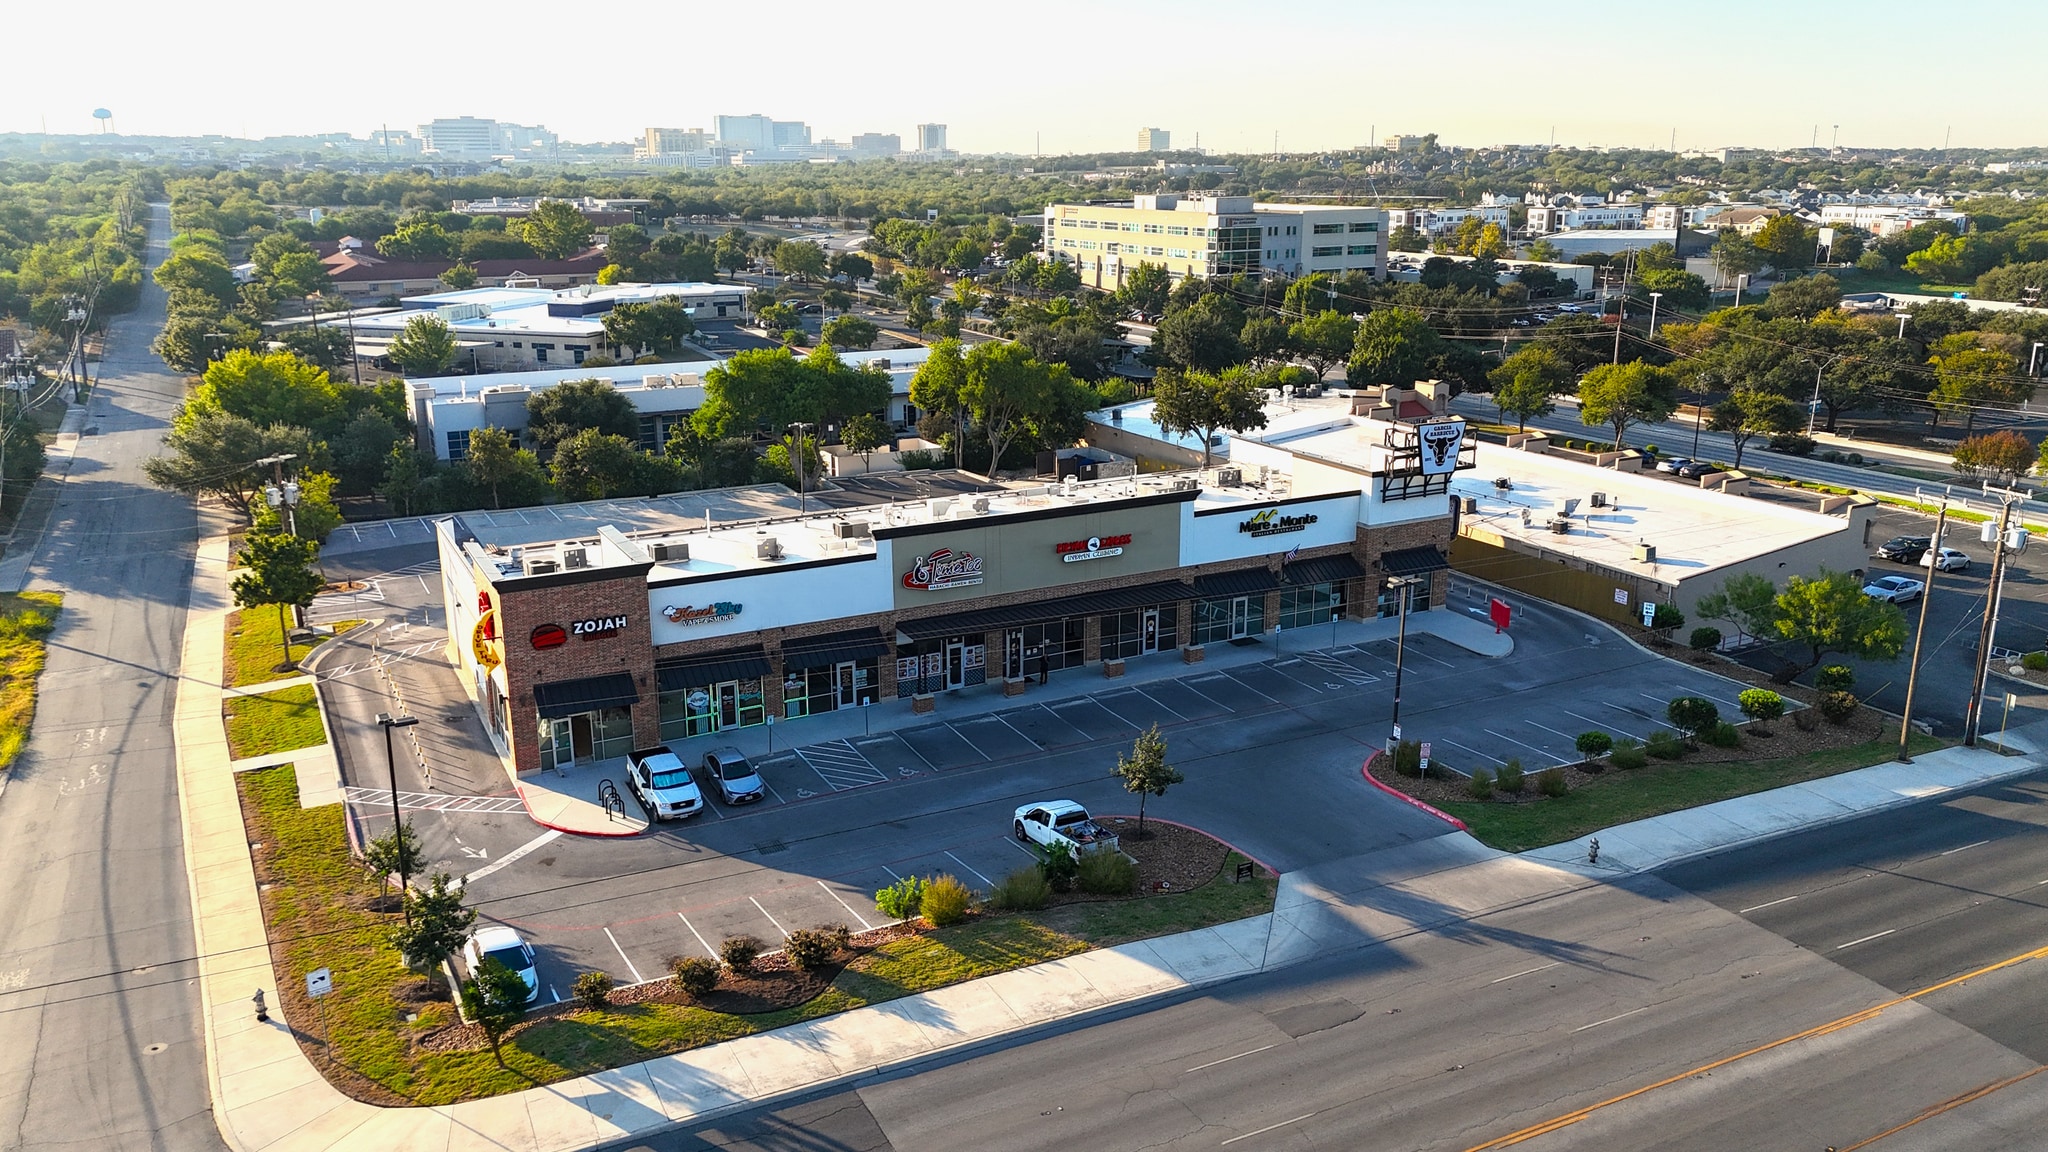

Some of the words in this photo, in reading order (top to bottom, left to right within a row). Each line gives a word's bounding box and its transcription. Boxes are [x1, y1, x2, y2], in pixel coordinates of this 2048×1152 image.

[1279, 513, 1319, 528] Monte
[573, 616, 627, 635] ZOJAH
[682, 618, 701, 627] VAPE
[709, 614, 734, 624] SMOKE
[474, 624, 484, 648] DRIVE
[478, 650, 499, 665] THRU
